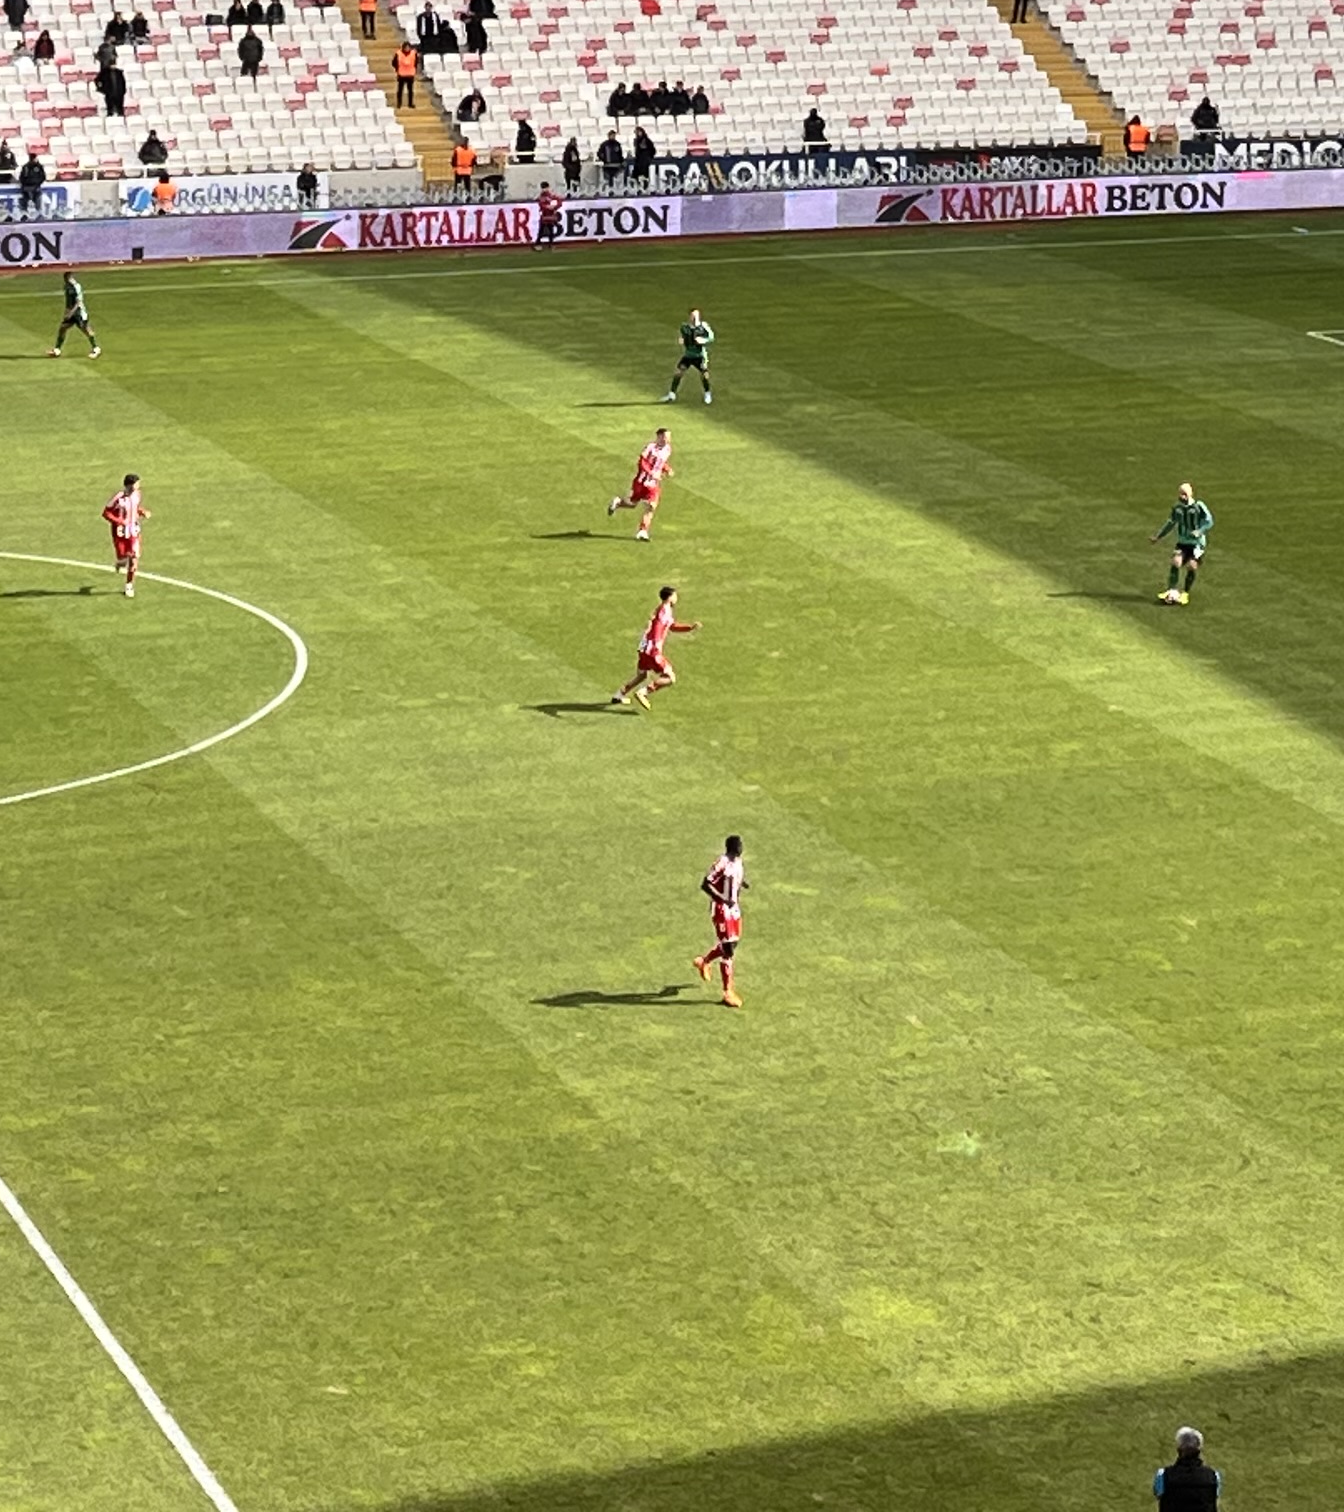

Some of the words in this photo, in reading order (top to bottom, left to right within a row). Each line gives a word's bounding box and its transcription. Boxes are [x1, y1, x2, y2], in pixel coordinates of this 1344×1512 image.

[939, 181, 1099, 222] KARTALLAR
[1105, 180, 1227, 213] BETON
[358, 206, 533, 248] KARTALLAR
